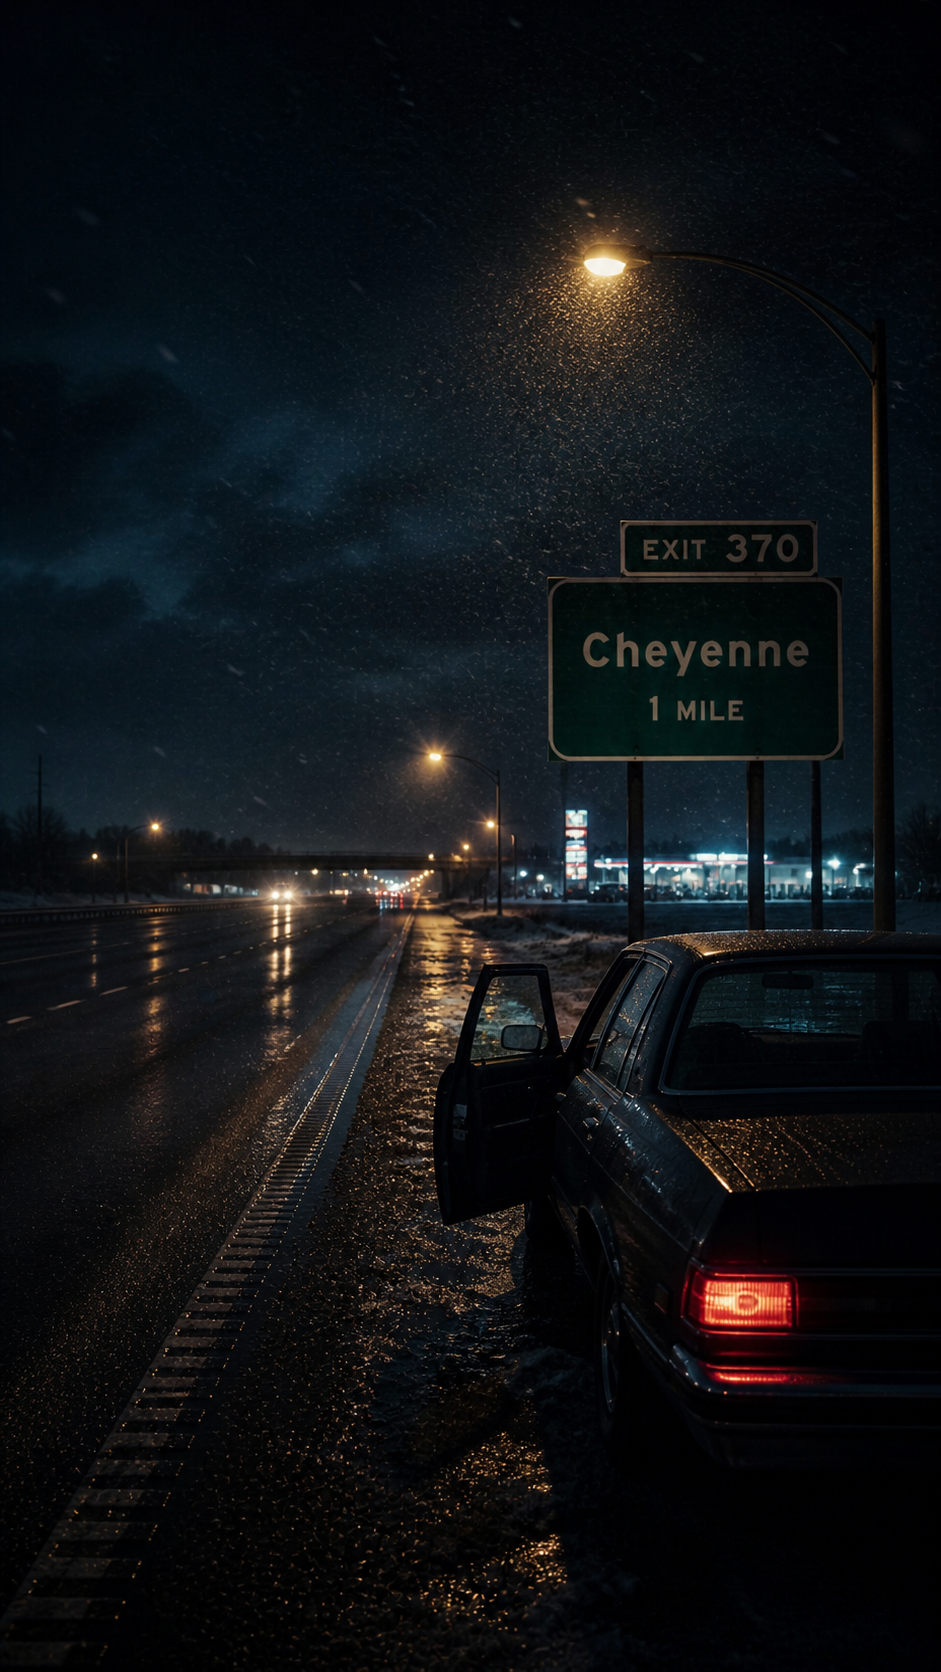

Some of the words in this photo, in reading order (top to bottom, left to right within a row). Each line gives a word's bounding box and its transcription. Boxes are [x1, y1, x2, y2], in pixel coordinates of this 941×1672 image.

[643, 539, 706, 560] EXIT
[726, 534, 799, 563] 370
[582, 631, 809, 677] Cheyenne
[649, 696, 659, 721] 1
[677, 700, 744, 721] MILE
